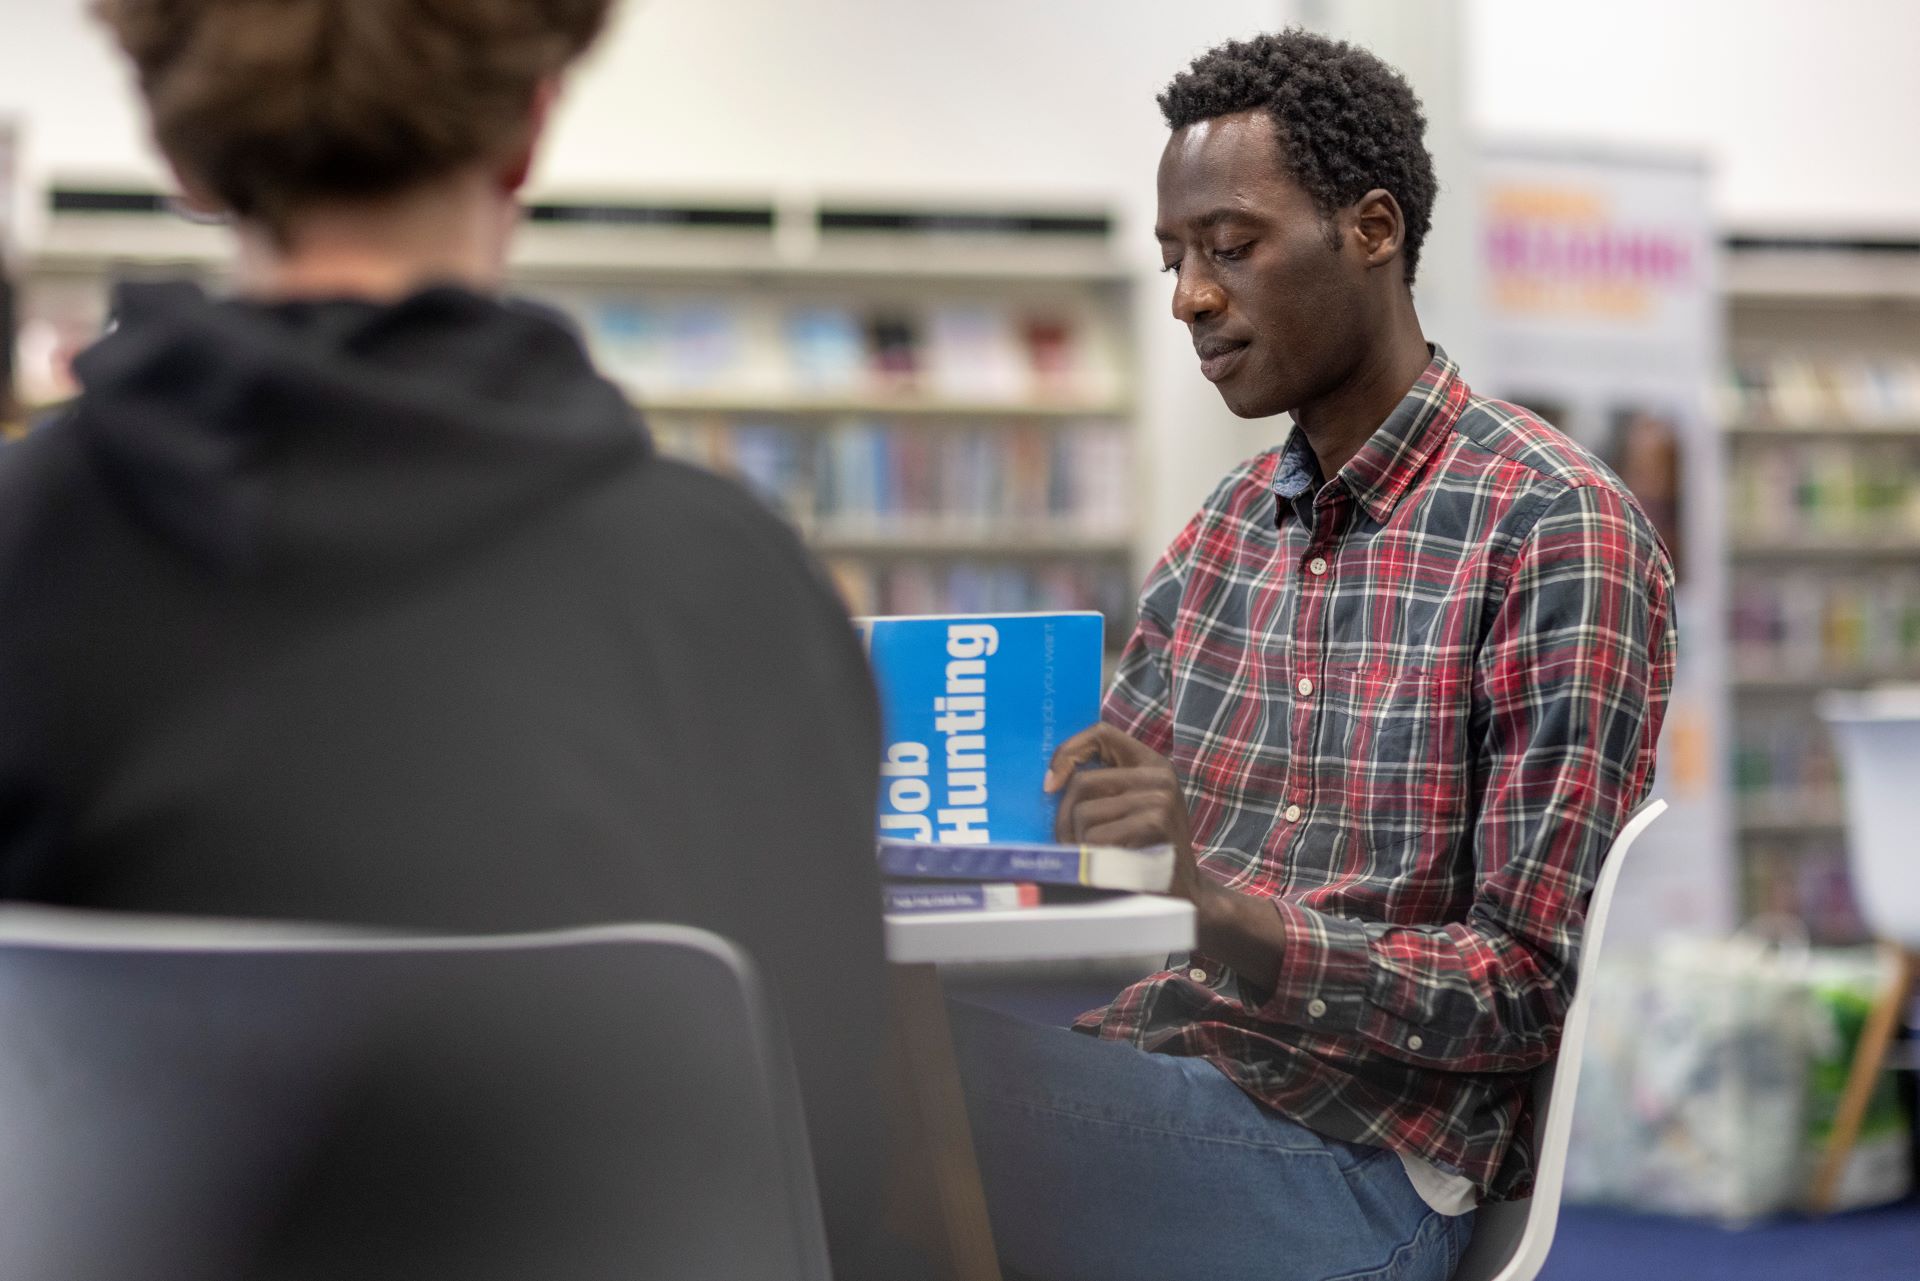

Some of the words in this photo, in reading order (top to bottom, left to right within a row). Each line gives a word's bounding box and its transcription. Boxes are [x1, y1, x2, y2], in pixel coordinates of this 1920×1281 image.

[1043, 623, 1056, 663] want
[1043, 666, 1057, 696] you
[1042, 698, 1057, 723] job
[935, 623, 999, 844] Hunting
[880, 741, 933, 844] Job
